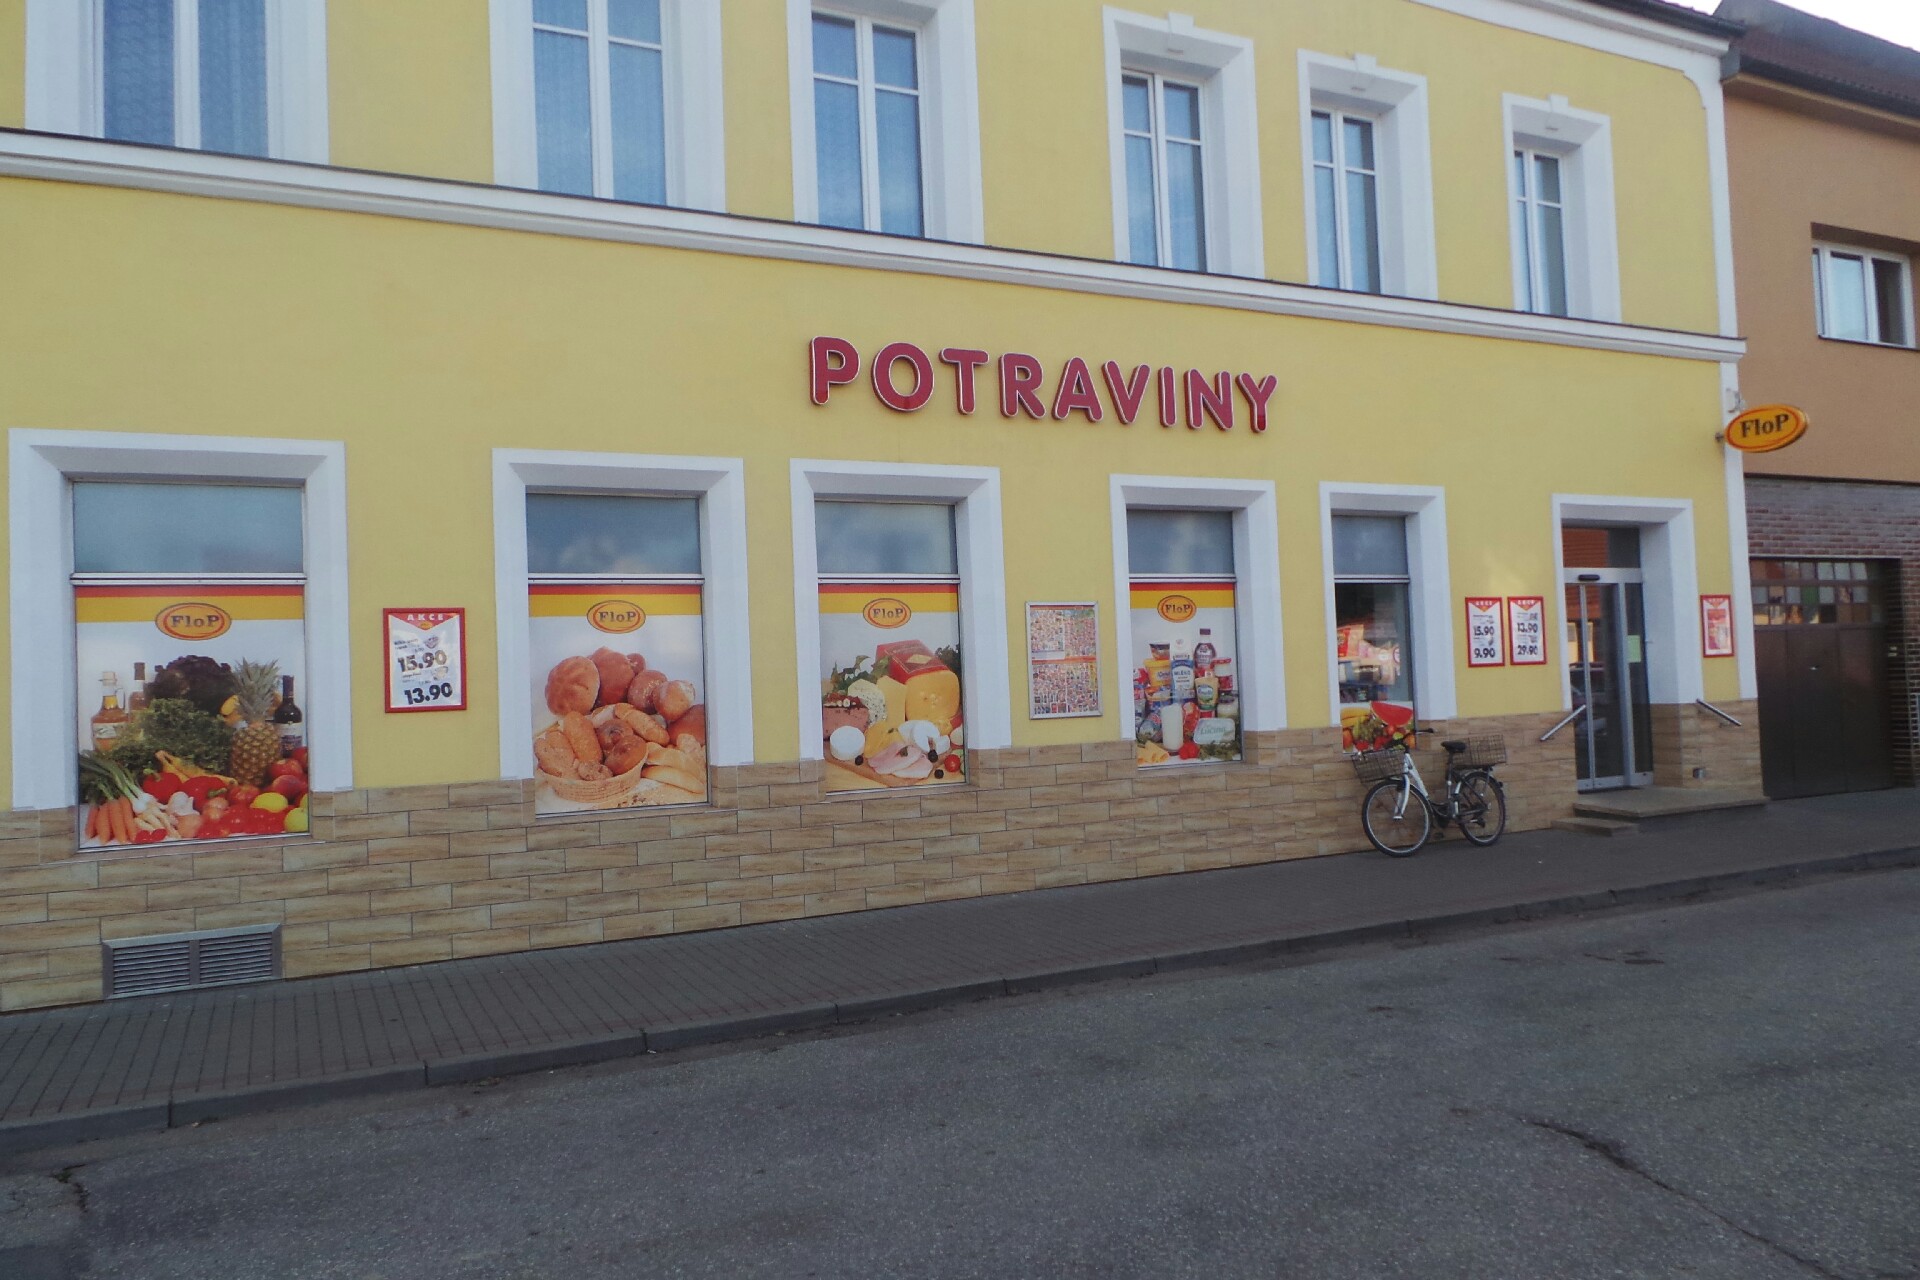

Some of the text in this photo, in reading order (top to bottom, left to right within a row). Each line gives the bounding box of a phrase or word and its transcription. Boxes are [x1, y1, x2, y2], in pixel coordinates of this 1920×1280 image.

[809, 335, 1278, 433] POTRAVINY
[1740, 413, 1790, 438] FloP
[871, 608, 905, 619] FloP
[1165, 604, 1192, 614] FloP
[170, 614, 220, 628] FloP
[407, 613, 444, 621] AKCE
[598, 612, 637, 623] FloP
[1474, 647, 1496, 659] 9.90
[397, 649, 448, 673] 15.90
[404, 682, 453, 705] 13.90
